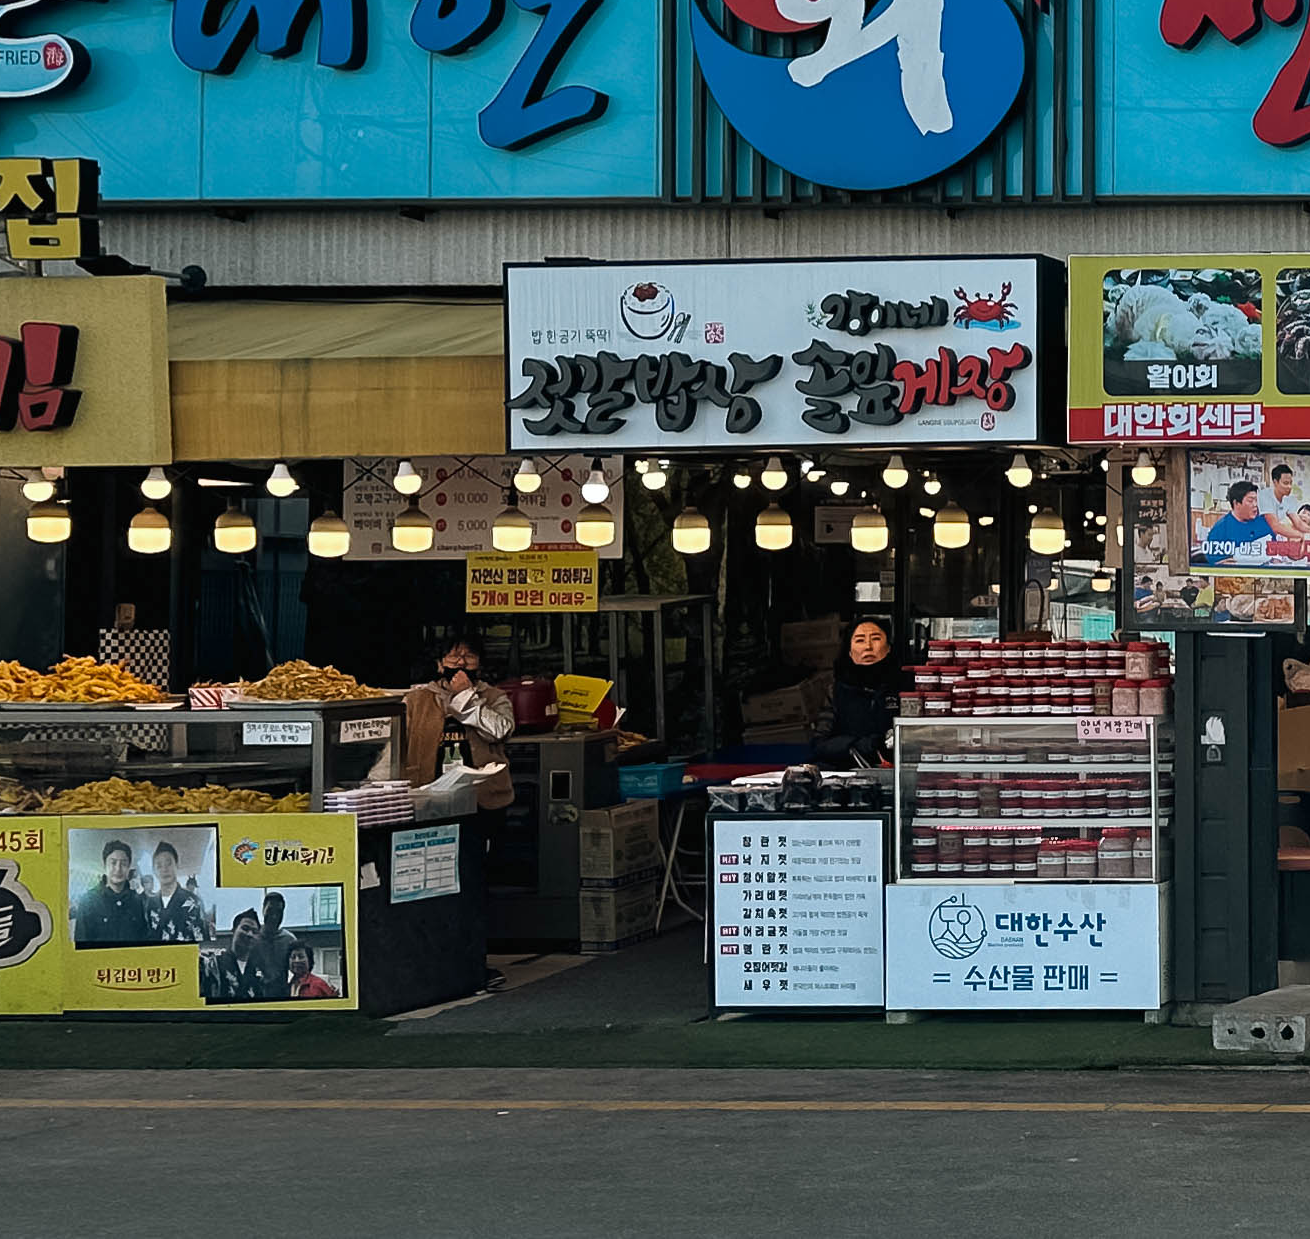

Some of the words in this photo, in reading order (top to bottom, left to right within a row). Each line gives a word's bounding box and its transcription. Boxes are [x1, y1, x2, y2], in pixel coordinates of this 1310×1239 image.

[531, 329, 542, 345] 밥
[1146, 363, 1219, 389] 활어회
[505, 350, 785, 436] 젓갈밥상
[791, 338, 1033, 434] 솔잎게장
[1102, 402, 1265, 438] 대한회센타
[1201, 539, 1236, 556] 이것이
[1239, 539, 1262, 556] 바로
[470, 567, 504, 585] 자연산
[506, 567, 528, 585] 껍질
[550, 567, 593, 585] 대하튀김
[470, 590, 509, 606] 5개에
[513, 590, 544, 606] 만원
[264, 846, 335, 867] 만세튀김
[995, 911, 1107, 948] 대한수산
[96, 968, 144, 985] 튀김의
[146, 967, 177, 985] 명가
[963, 964, 1035, 992] 수산물
[1042, 964, 1090, 992] 판매
